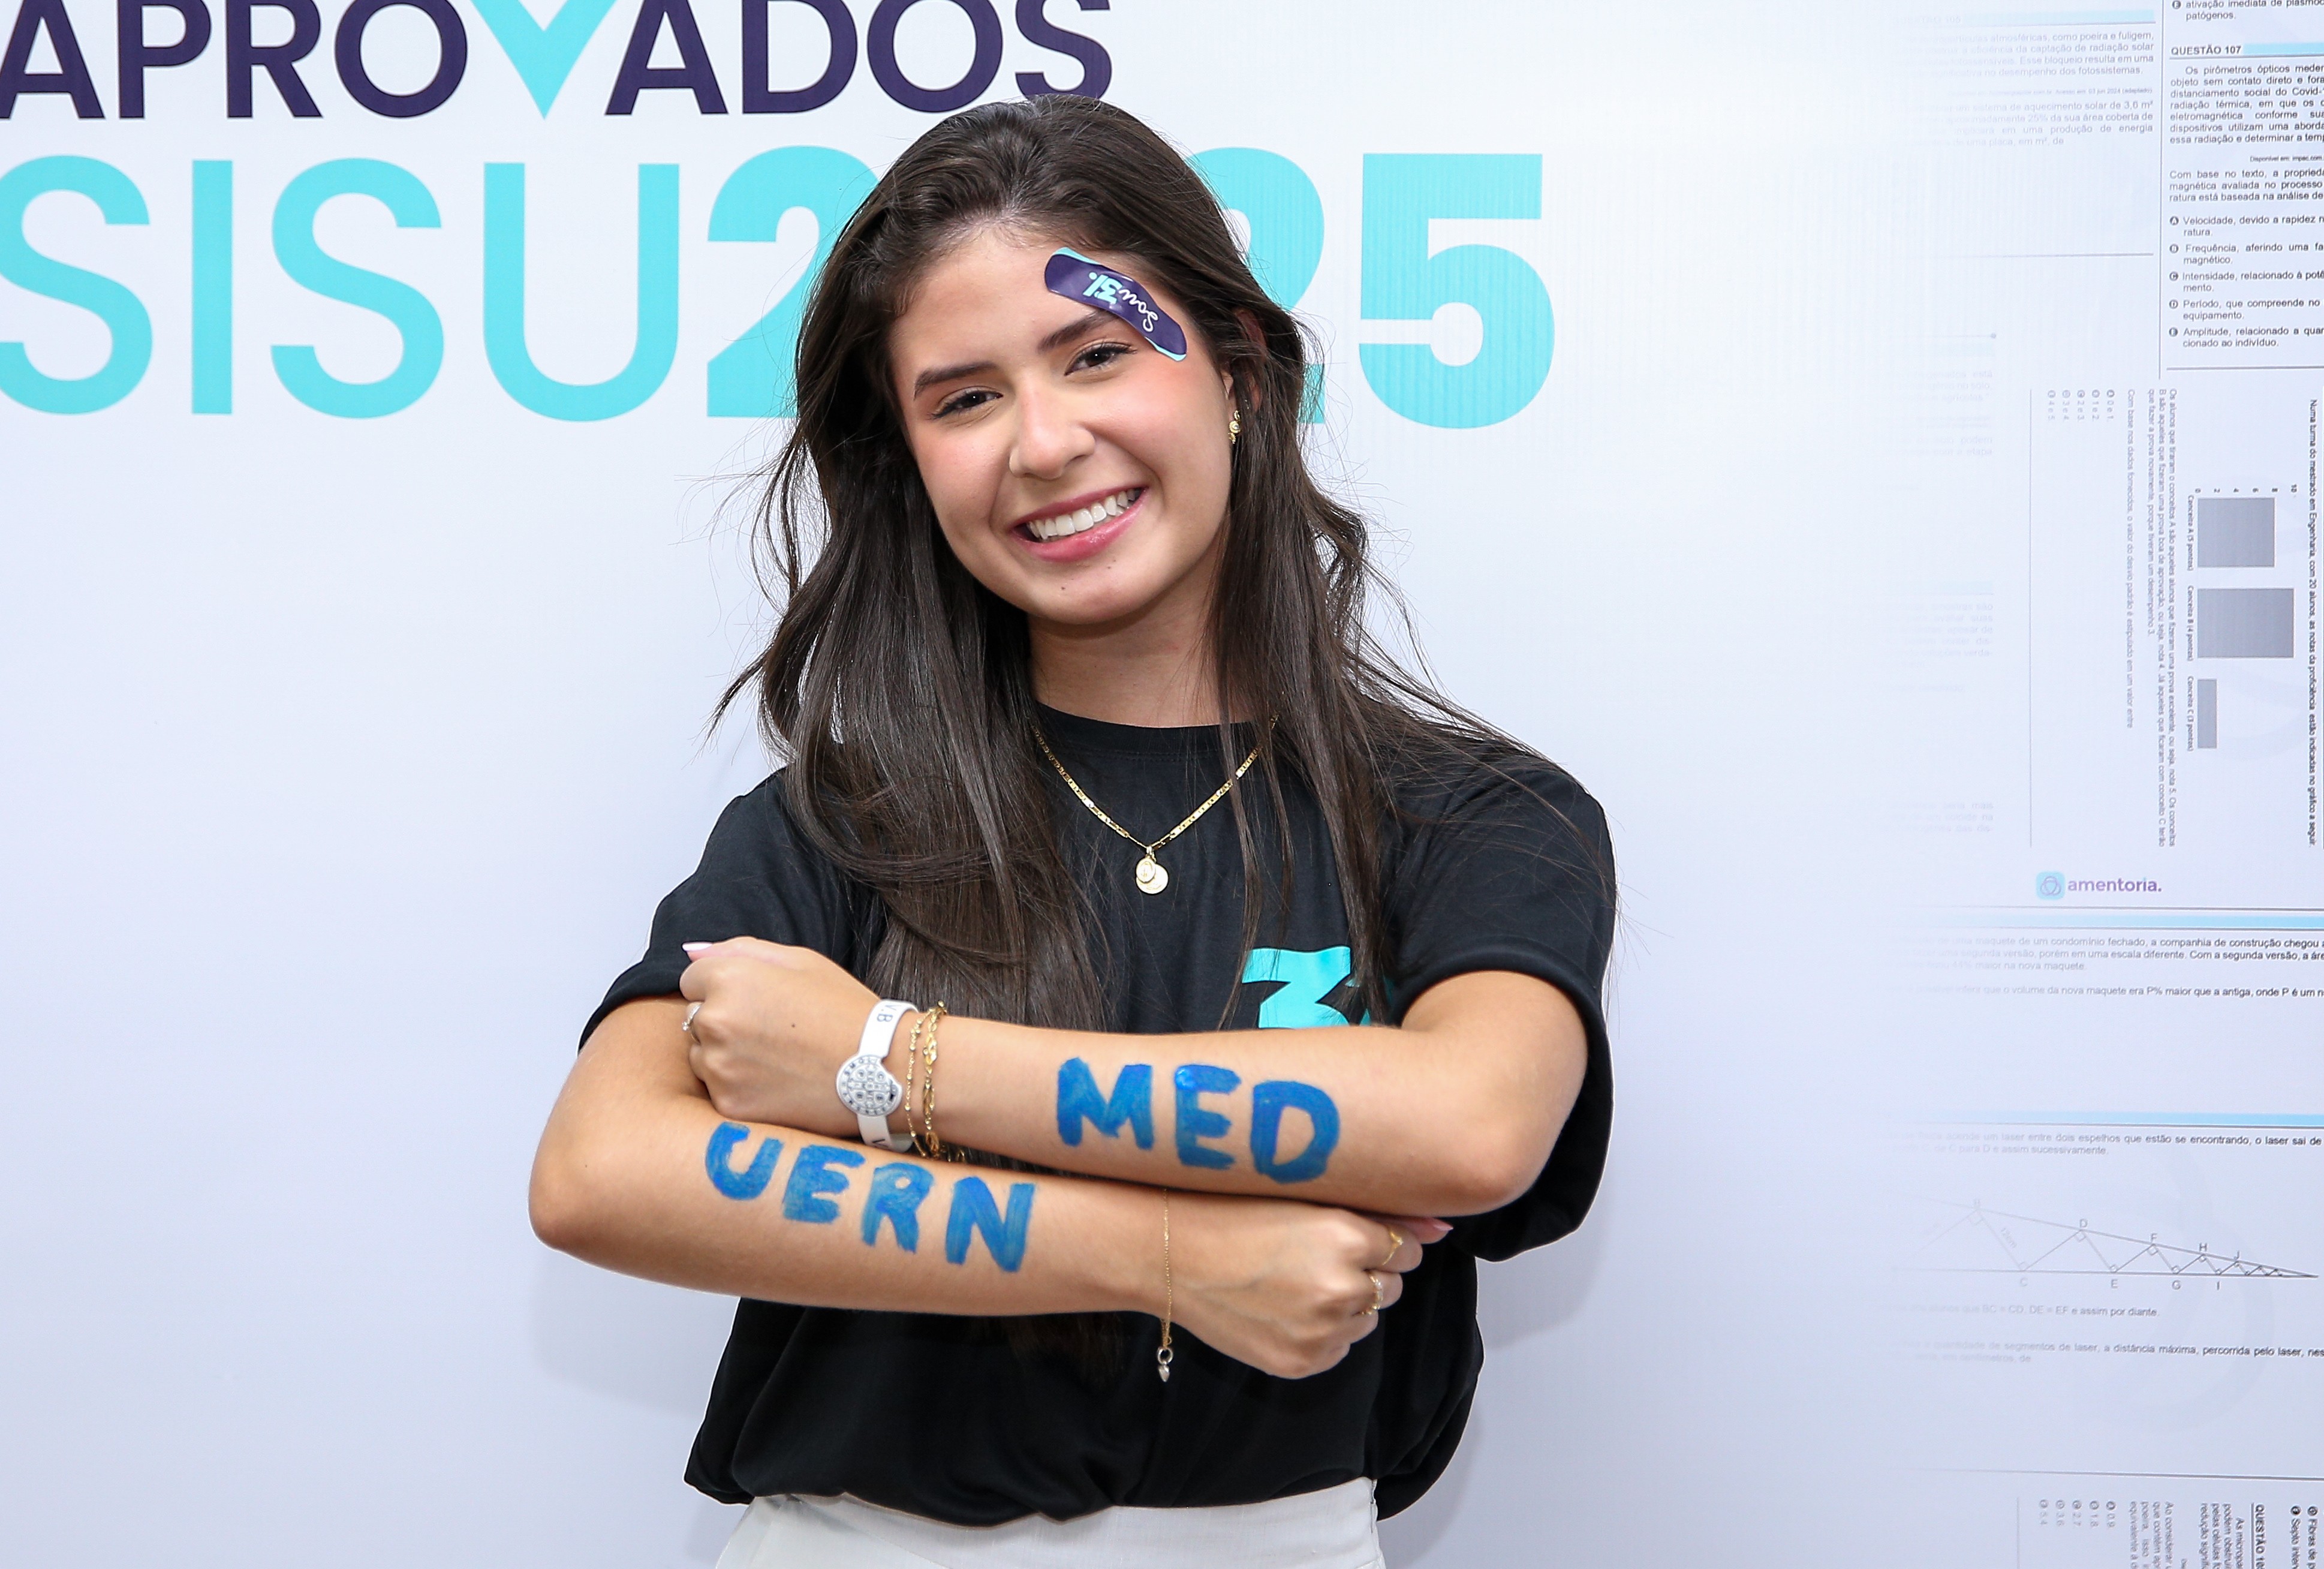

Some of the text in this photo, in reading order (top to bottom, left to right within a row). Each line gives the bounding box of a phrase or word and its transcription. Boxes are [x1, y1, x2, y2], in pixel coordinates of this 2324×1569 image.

[2185, 0, 2224, 9] ativação
[2185, 11, 2236, 22] patógenos.
[2171, 44, 2242, 55] QUESTÃO 107
[2185, 66, 2198, 75] Os
[2203, 65, 2252, 74] pirômetros
[2257, 64, 2290, 75] ópticos
[2171, 78, 2199, 88] objeto
[2227, 76, 2262, 85] contato
[2266, 76, 2293, 84] direto
[2171, 89, 2240, 98] distanciamento
[2244, 88, 2271, 97] social
[2169, 100, 2210, 110] radiação
[2216, 100, 2252, 109] térmica,
[2278, 100, 2296, 109] que
[2169, 111, 2244, 122] eletromagnética
[2254, 110, 2298, 119] conforme
[2169, 123, 2223, 133] dispositivos
[2228, 122, 2264, 131] utilizam
[2194, 134, 2234, 145] radiação
[2245, 133, 2294, 142] determinar
[2169, 170, 2192, 179] Com
[2197, 170, 2220, 178] base
[2241, 169, 2268, 178] texto,
[2169, 182, 2216, 192] magnética
[2221, 181, 2259, 190] avaliada
[2281, 181, 2323, 190] processo
[2169, 193, 2197, 202] ratura
[2198, 193, 2218, 201] está
[2221, 192, 2260, 201] baseada
[2276, 191, 2310, 200] análise
[2311, 191, 2324, 199] de
[2181, 215, 2316, 225] Velocidade, devido rapidez
[2185, 244, 2239, 254] Frequência,
[2245, 243, 2283, 251] aferindo
[2182, 256, 2234, 266] magnético.
[2182, 272, 2238, 281] Intensidade,
[2240, 271, 2294, 279] relacionado
[2182, 299, 2222, 309] Período,
[2226, 300, 2244, 309] que
[2247, 299, 2305, 308] compreende
[2182, 311, 2245, 320] equipamento.
[2182, 327, 2232, 336] Amplitude,
[2235, 326, 2289, 335] relacionado
[2182, 338, 2220, 347] cionado
[2235, 338, 2278, 347] indivíduo.
[2067, 878, 2162, 892] amentoria.
[1056, 1056, 1340, 1185] MED
[704, 1122, 1035, 1272] UERN
[2256, 1504, 2265, 1553] QUESTÃO
